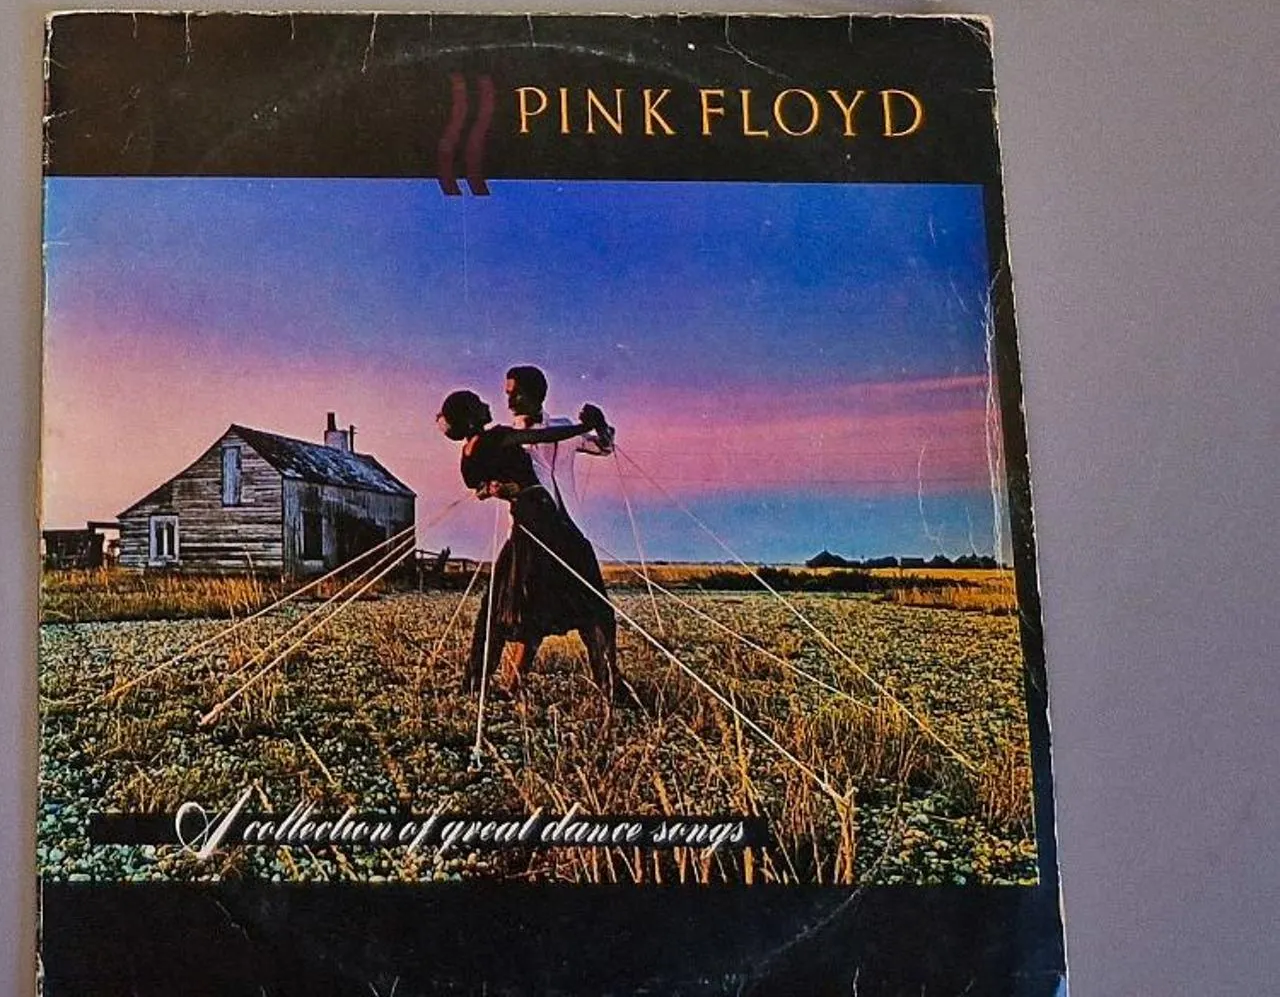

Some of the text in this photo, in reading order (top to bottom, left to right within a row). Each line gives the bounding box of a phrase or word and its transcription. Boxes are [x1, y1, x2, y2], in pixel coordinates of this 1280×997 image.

[513, 86, 923, 138] PINK FLOYD
[242, 800, 394, 842] collection
[398, 800, 454, 856] of
[434, 805, 543, 856] great
[540, 802, 643, 844] dance
[650, 819, 745, 859] songs
